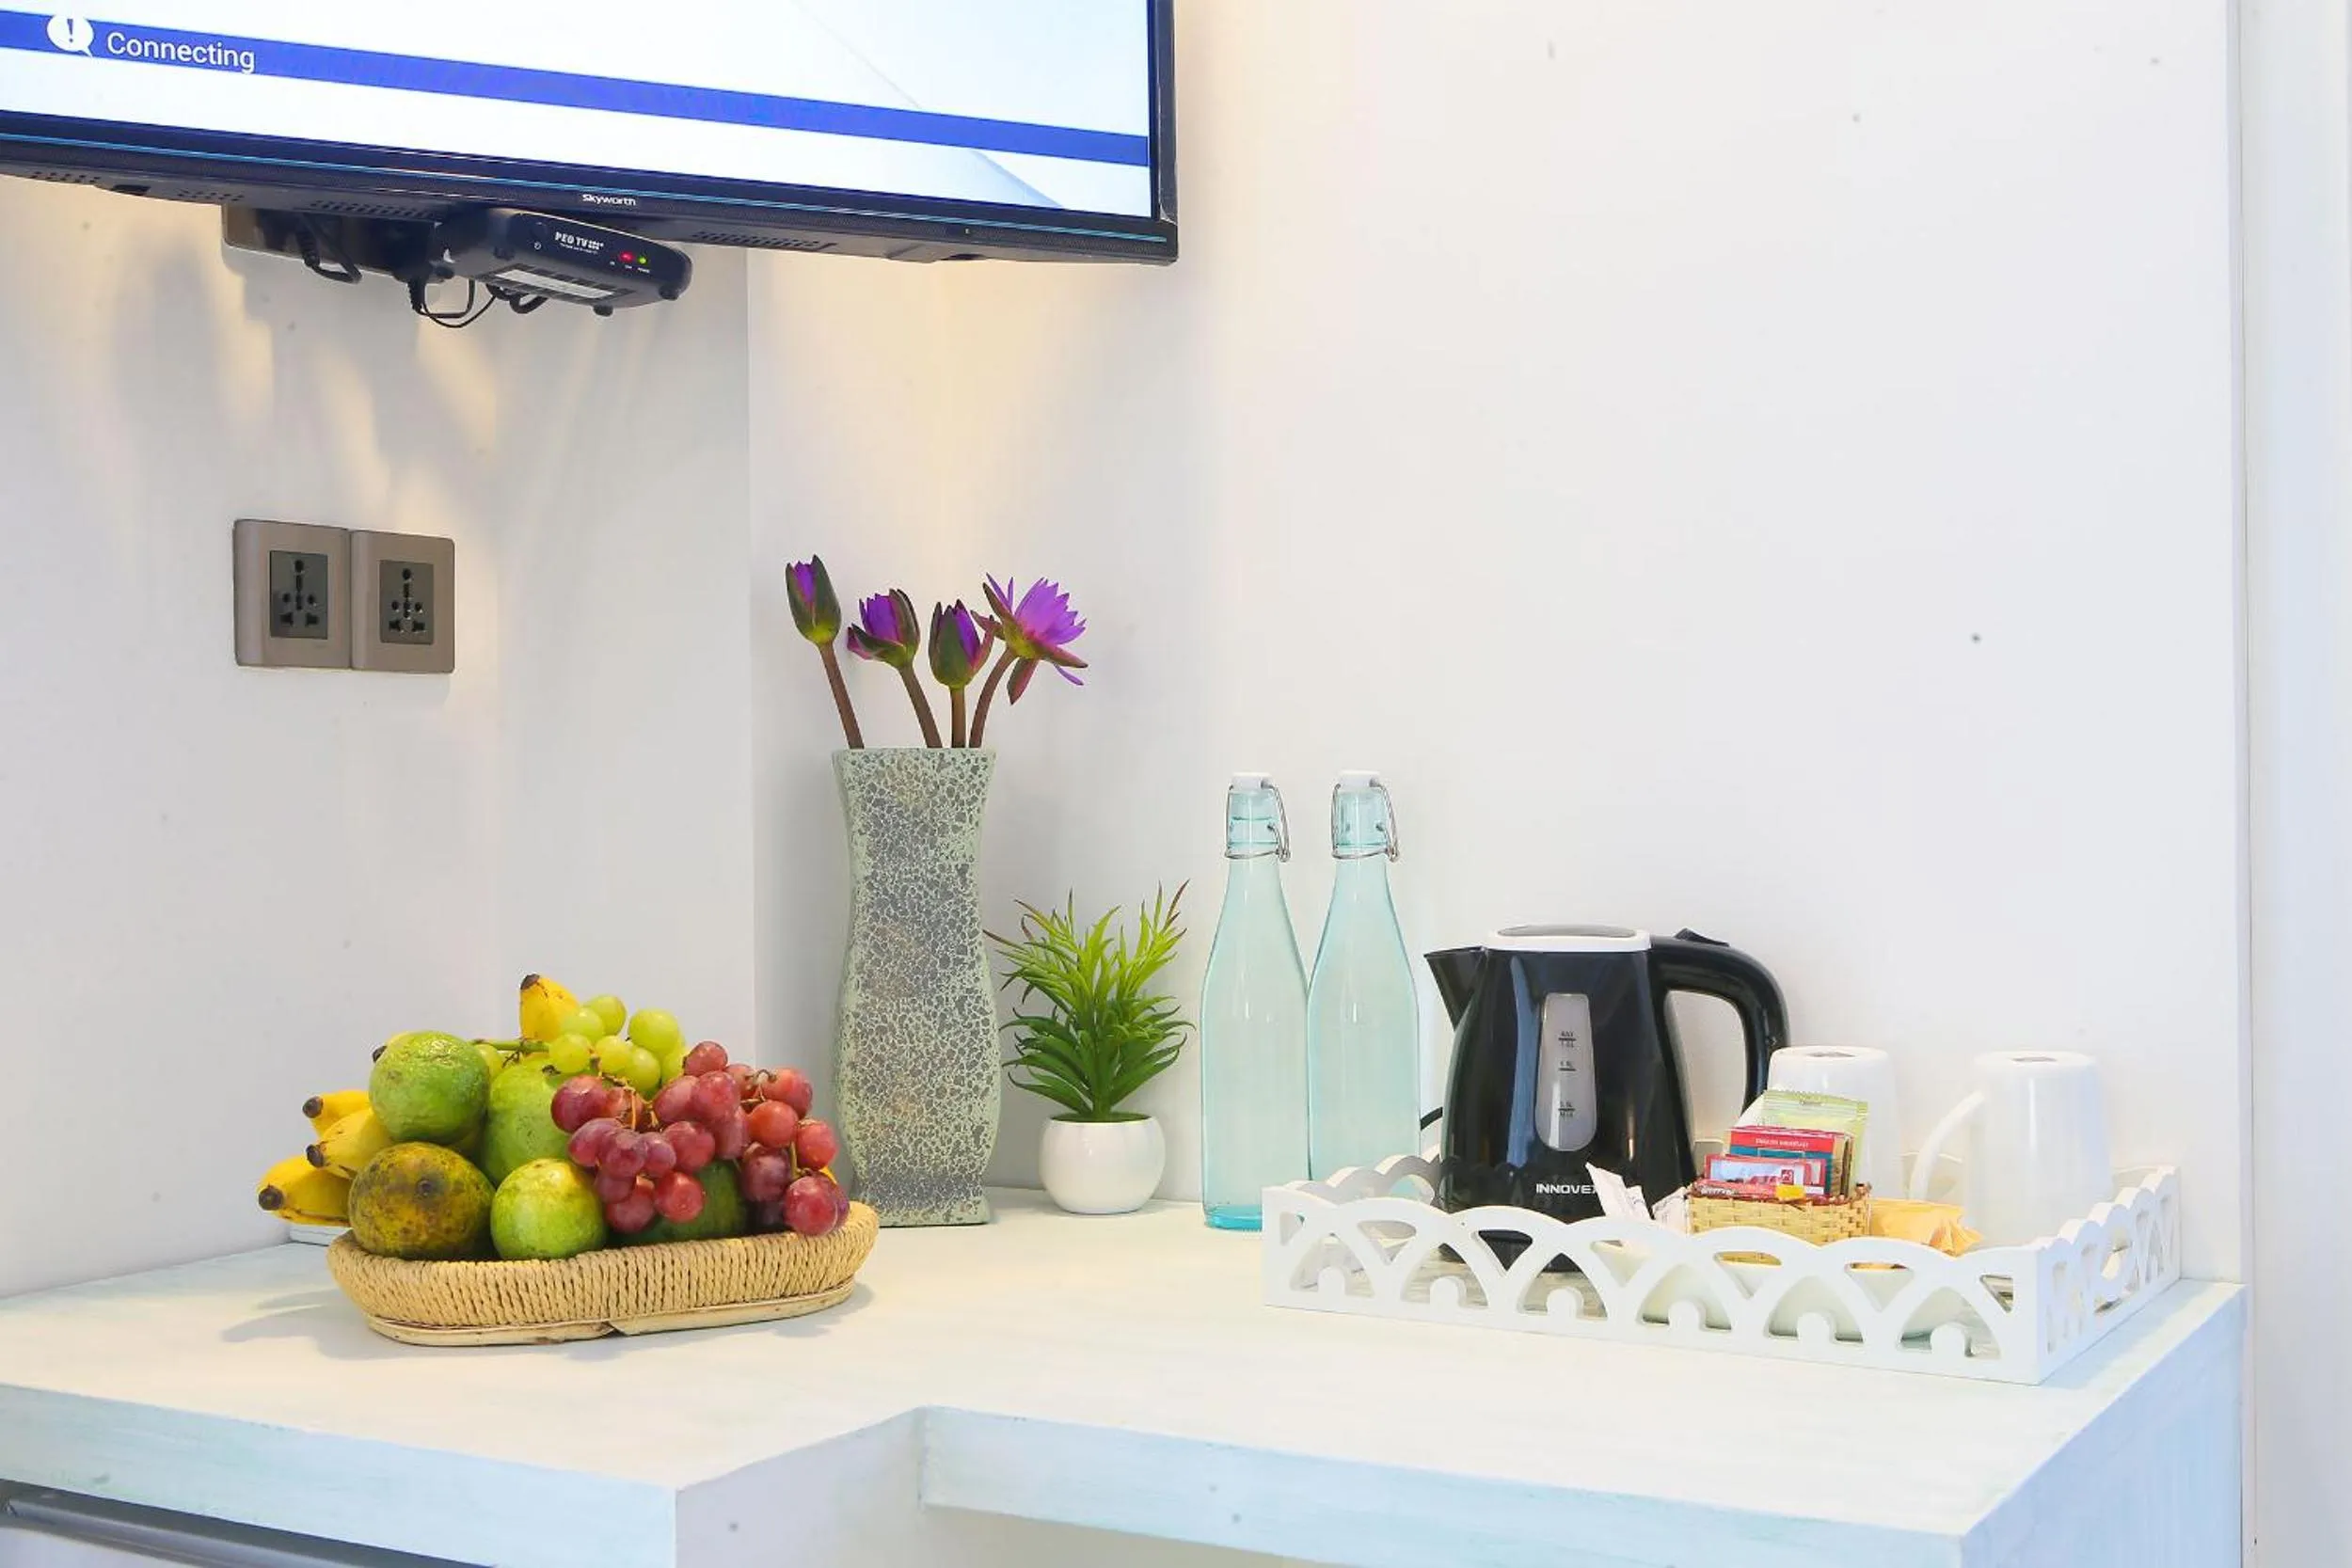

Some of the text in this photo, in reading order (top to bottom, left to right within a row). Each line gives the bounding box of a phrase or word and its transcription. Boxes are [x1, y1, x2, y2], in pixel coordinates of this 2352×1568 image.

[106, 32, 255, 74] Connecting
[582, 194, 636, 206] Skyworth
[576, 236, 588, 247] TV
